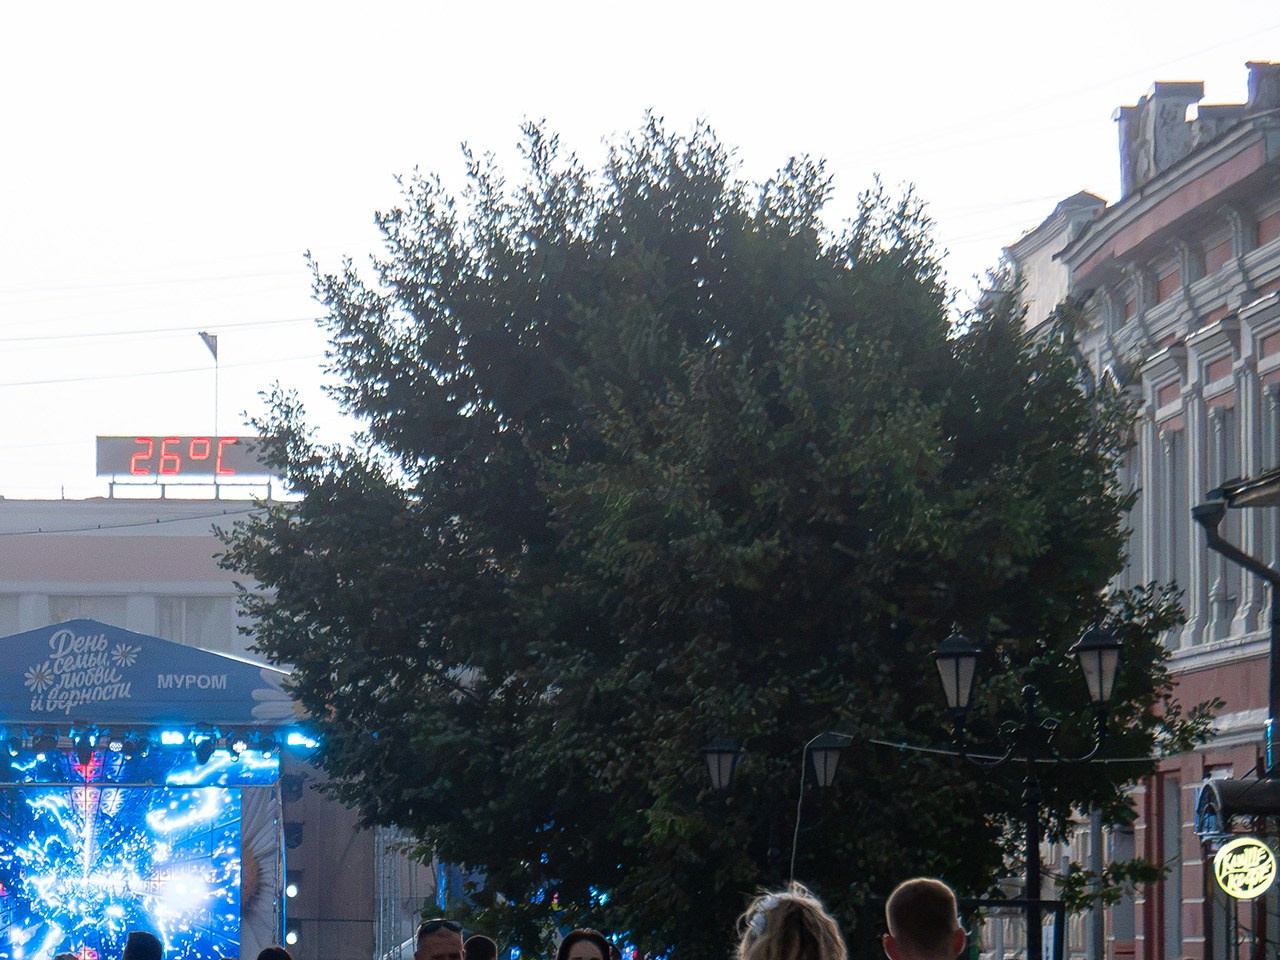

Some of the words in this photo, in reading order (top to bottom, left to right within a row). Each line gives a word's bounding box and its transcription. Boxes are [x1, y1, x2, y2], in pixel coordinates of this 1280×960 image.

[49, 629, 109, 659] День
[56, 666, 123, 690] любви
[157, 674, 227, 690] МУРОМ
[30, 695, 44, 712] и
[46, 682, 132, 715] верности
